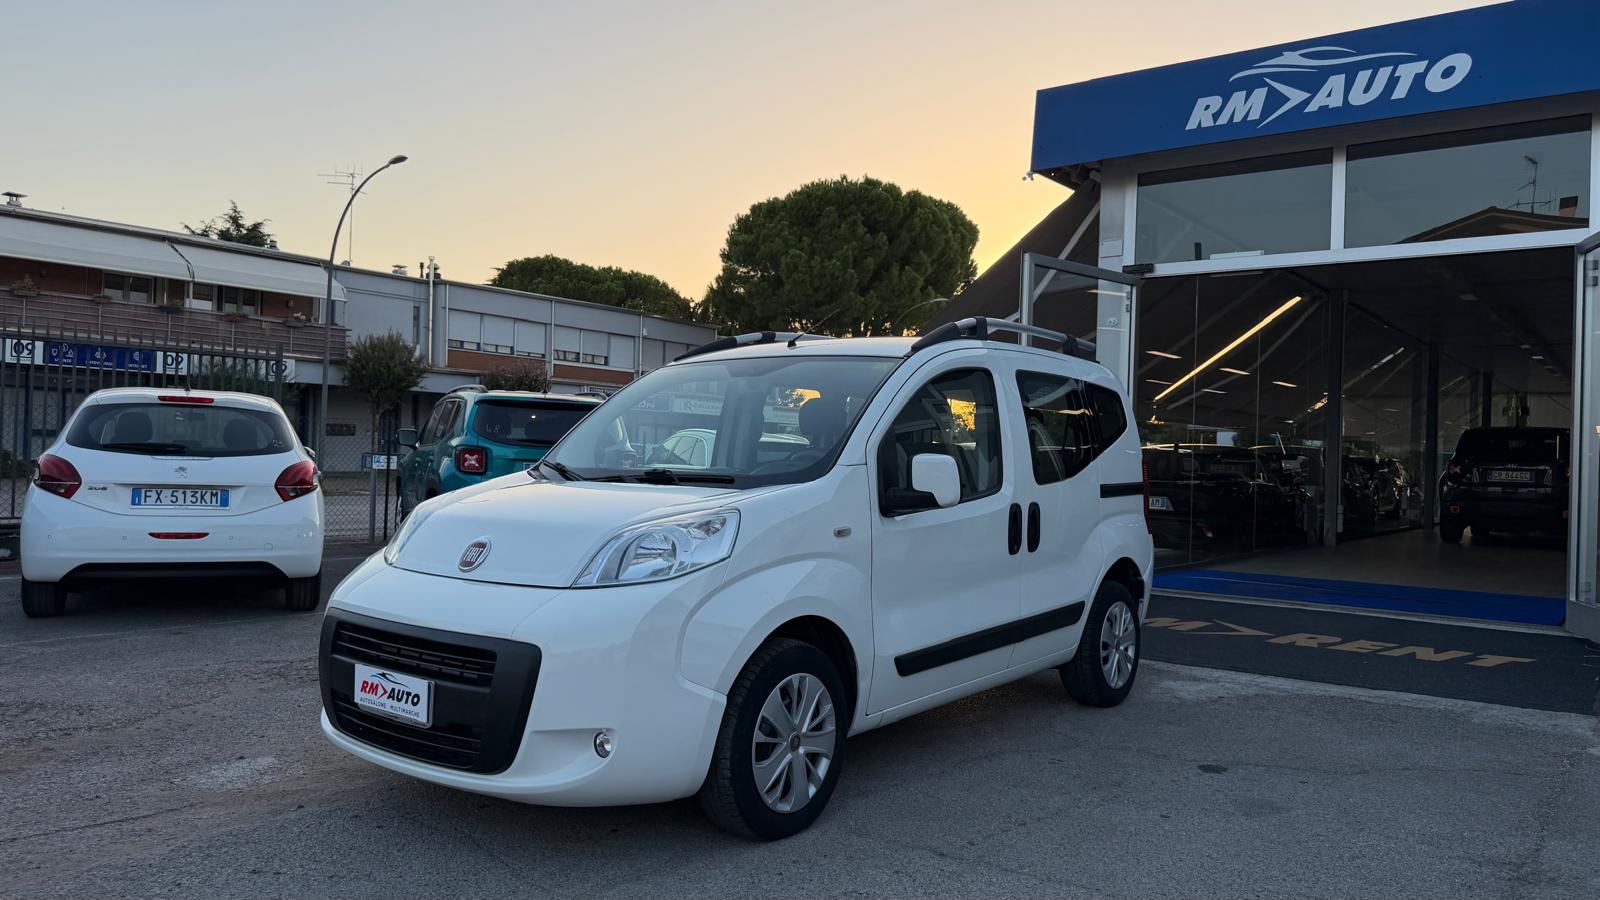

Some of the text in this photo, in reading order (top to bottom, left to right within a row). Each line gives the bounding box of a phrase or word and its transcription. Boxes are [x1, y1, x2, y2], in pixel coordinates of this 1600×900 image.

[1185, 53, 1473, 130] RM AUTO
[463, 546, 484, 563] FIAT
[1265, 633, 1537, 667] RENT
[360, 680, 421, 707] RM AUTO
